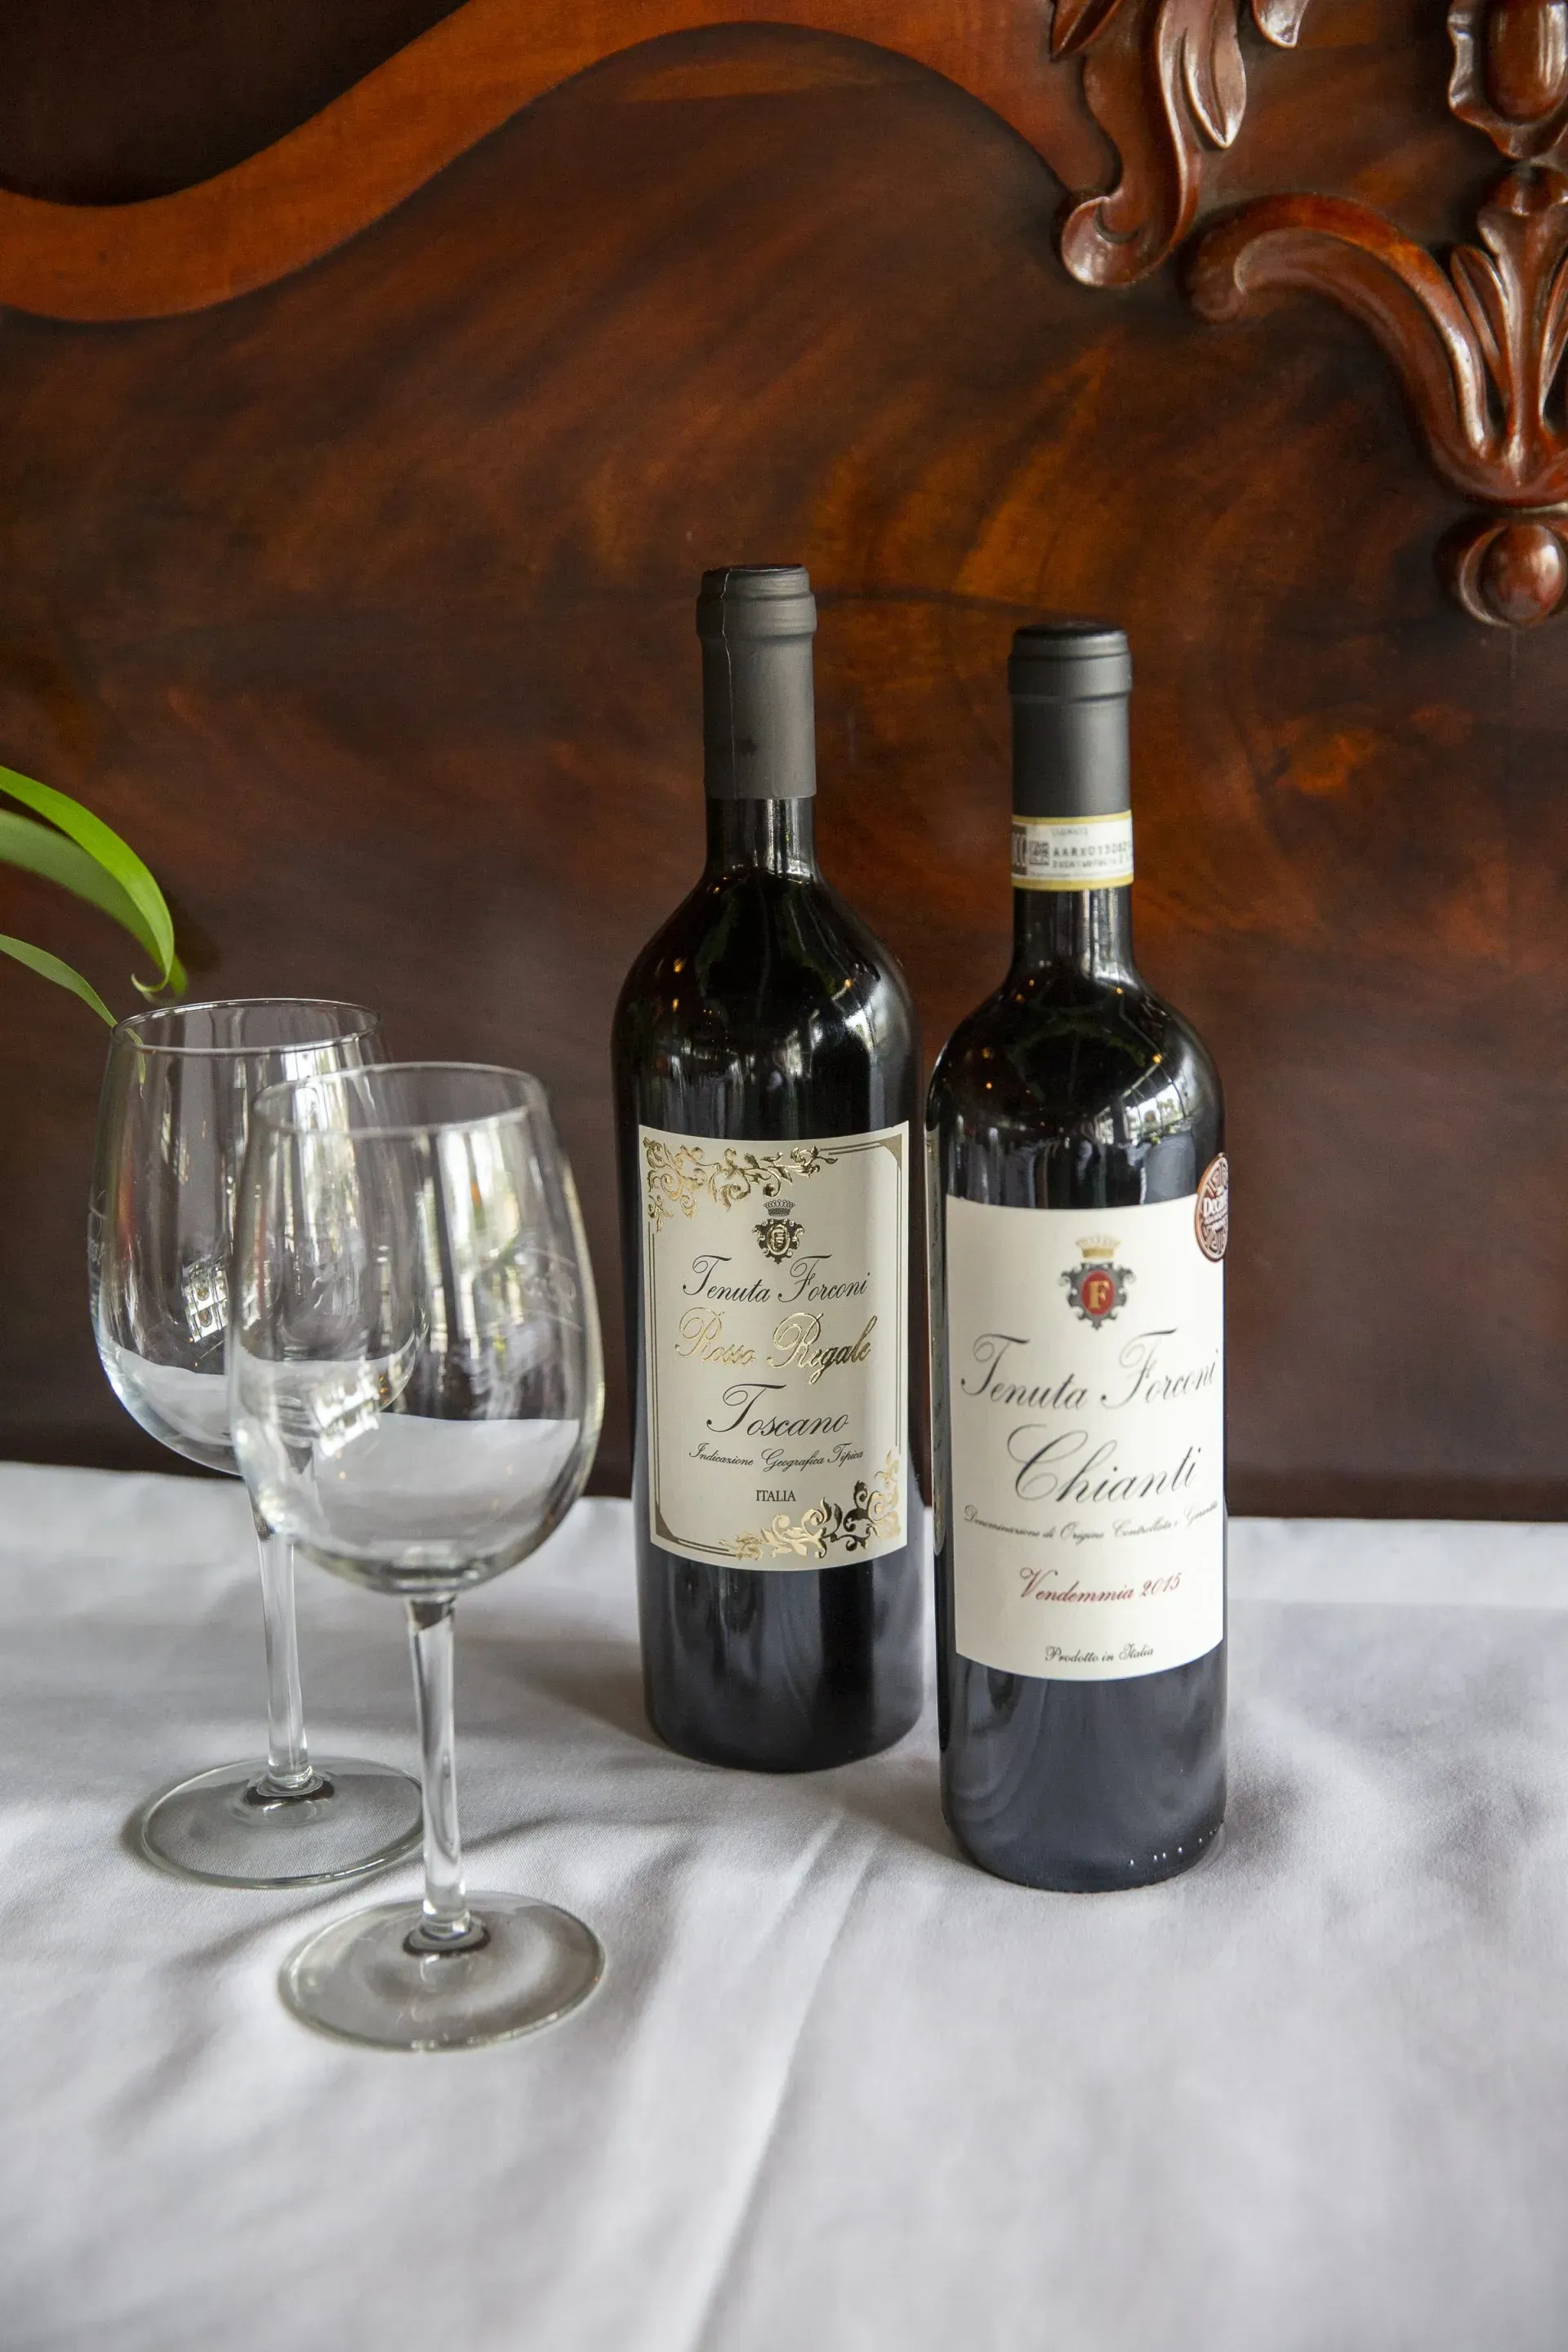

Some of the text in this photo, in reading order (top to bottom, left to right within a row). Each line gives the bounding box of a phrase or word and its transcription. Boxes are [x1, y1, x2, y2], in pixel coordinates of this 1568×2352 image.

[682, 1254, 871, 1303] Tenuta Forconi
[1089, 1280, 1110, 1310] F
[675, 1307, 878, 1385] Rosso Regale
[960, 1328, 1218, 1410] Tenuta Forconi
[706, 1383, 849, 1437] Toscano
[688, 1442, 864, 1472] Indicazione Geografica Tipica
[1007, 1423, 1201, 1503] Chianti
[755, 1490, 796, 1502] ITALIA
[1020, 1566, 1183, 1603] Vendemmia 2015
[1045, 1642, 1154, 1664] Prodotto in Italia
